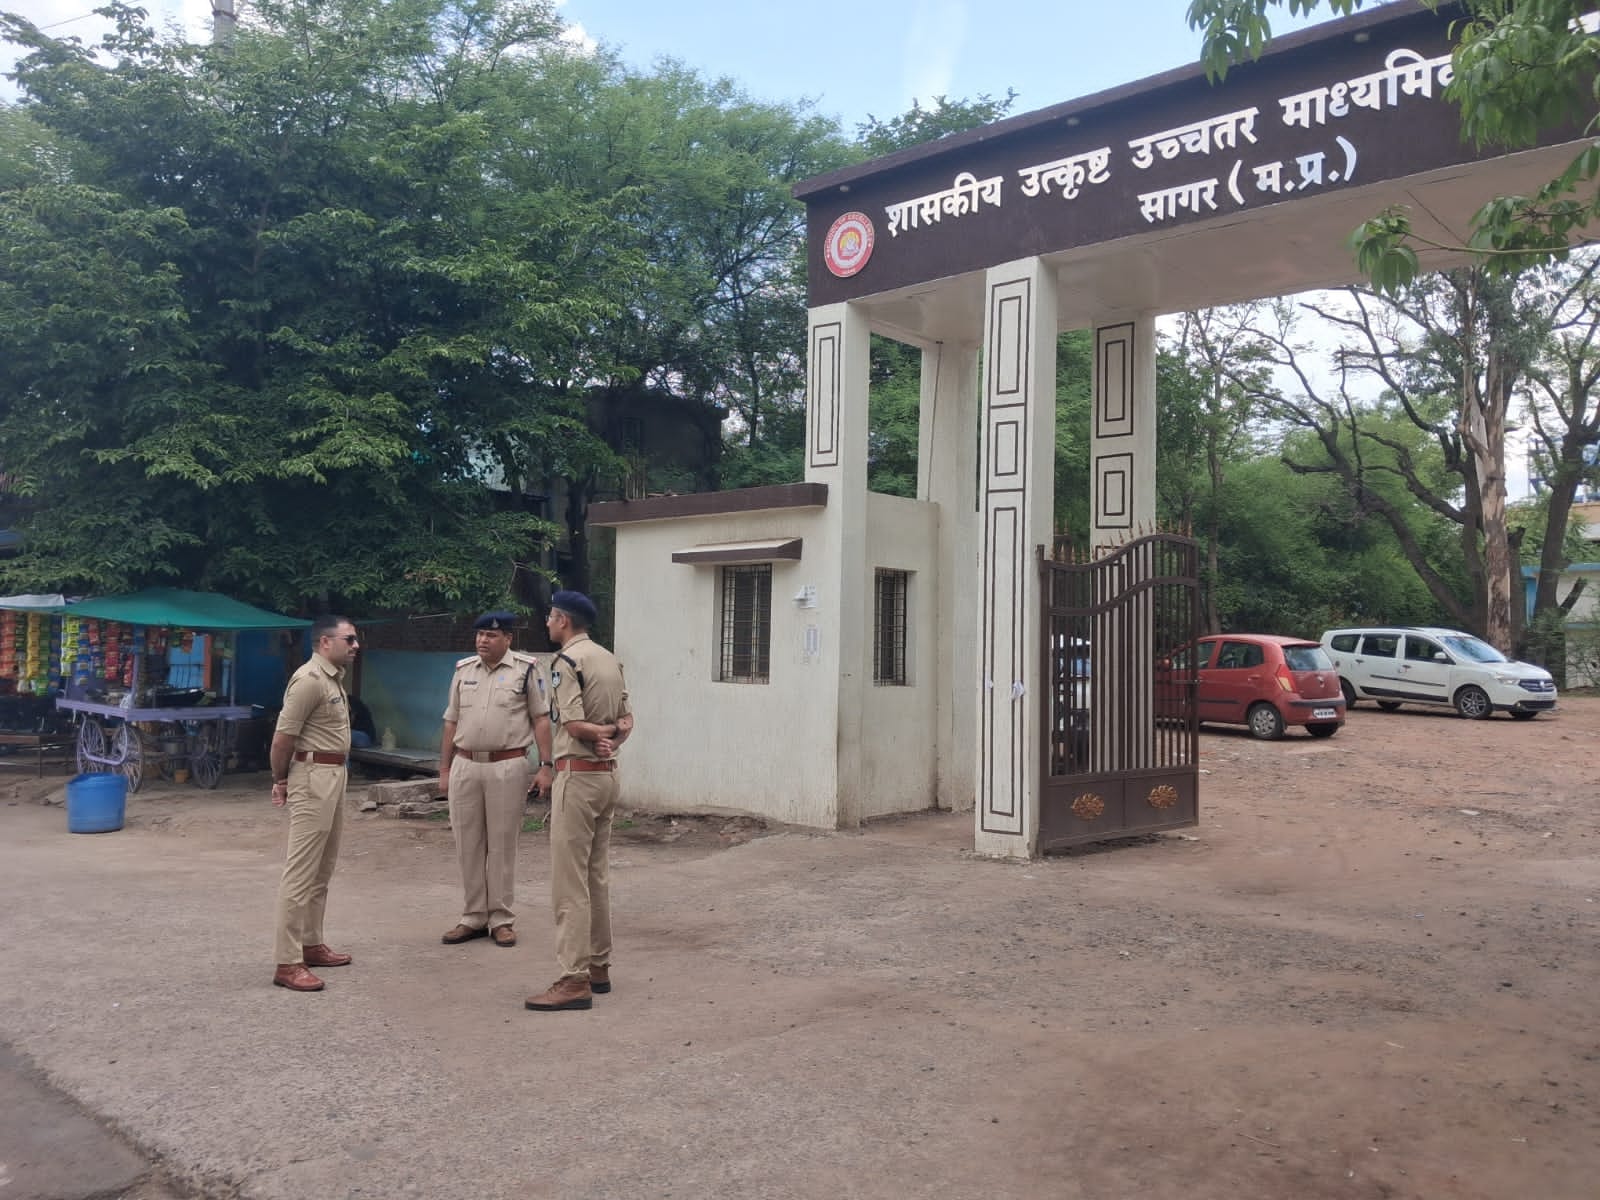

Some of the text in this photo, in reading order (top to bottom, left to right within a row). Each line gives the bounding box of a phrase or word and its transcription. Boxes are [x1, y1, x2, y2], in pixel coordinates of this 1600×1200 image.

[884, 171, 1004, 237] शासकीय
[1018, 147, 1112, 200] उत्कृष्ट
[1128, 106, 1260, 169] उच्चतर
[1136, 177, 1220, 224] सागर
